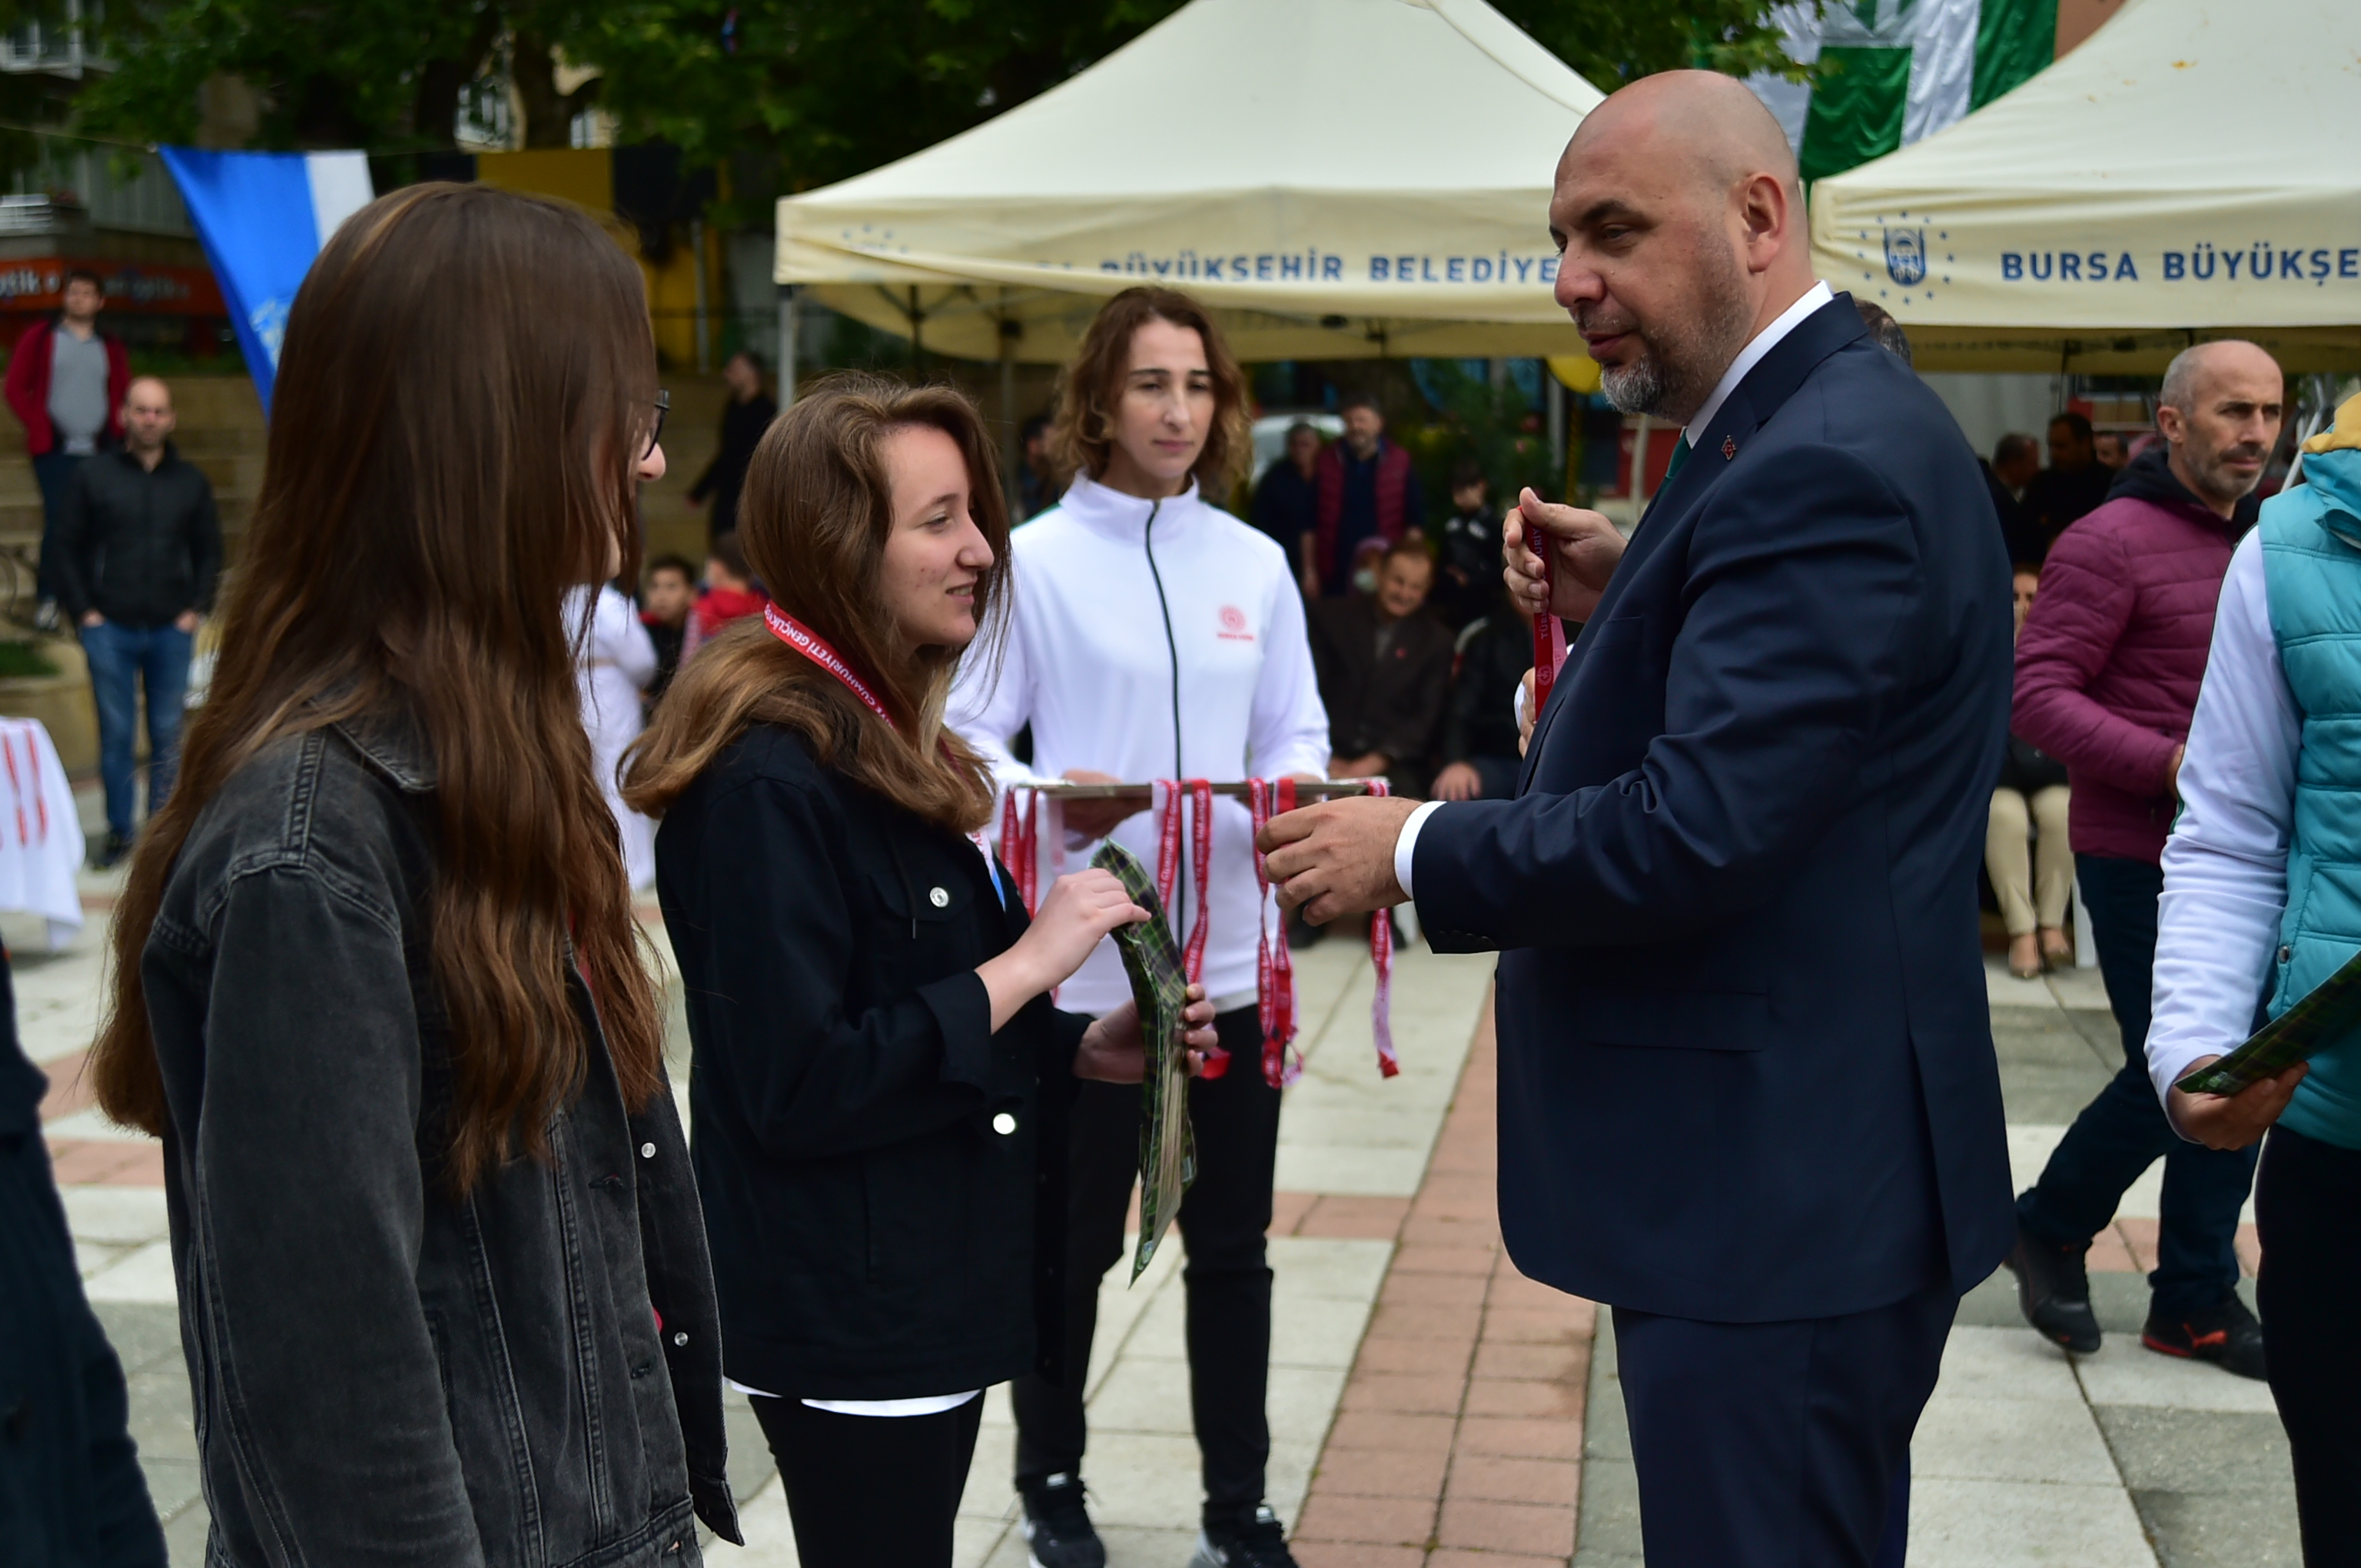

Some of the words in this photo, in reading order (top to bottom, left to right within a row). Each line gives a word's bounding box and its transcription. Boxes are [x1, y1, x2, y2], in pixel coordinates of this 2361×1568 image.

[2001, 251, 2138, 281] BURSA
[2163, 241, 2359, 287] BÜYÜKŞE
[805, 641, 876, 706] CUMHURİYETİ
